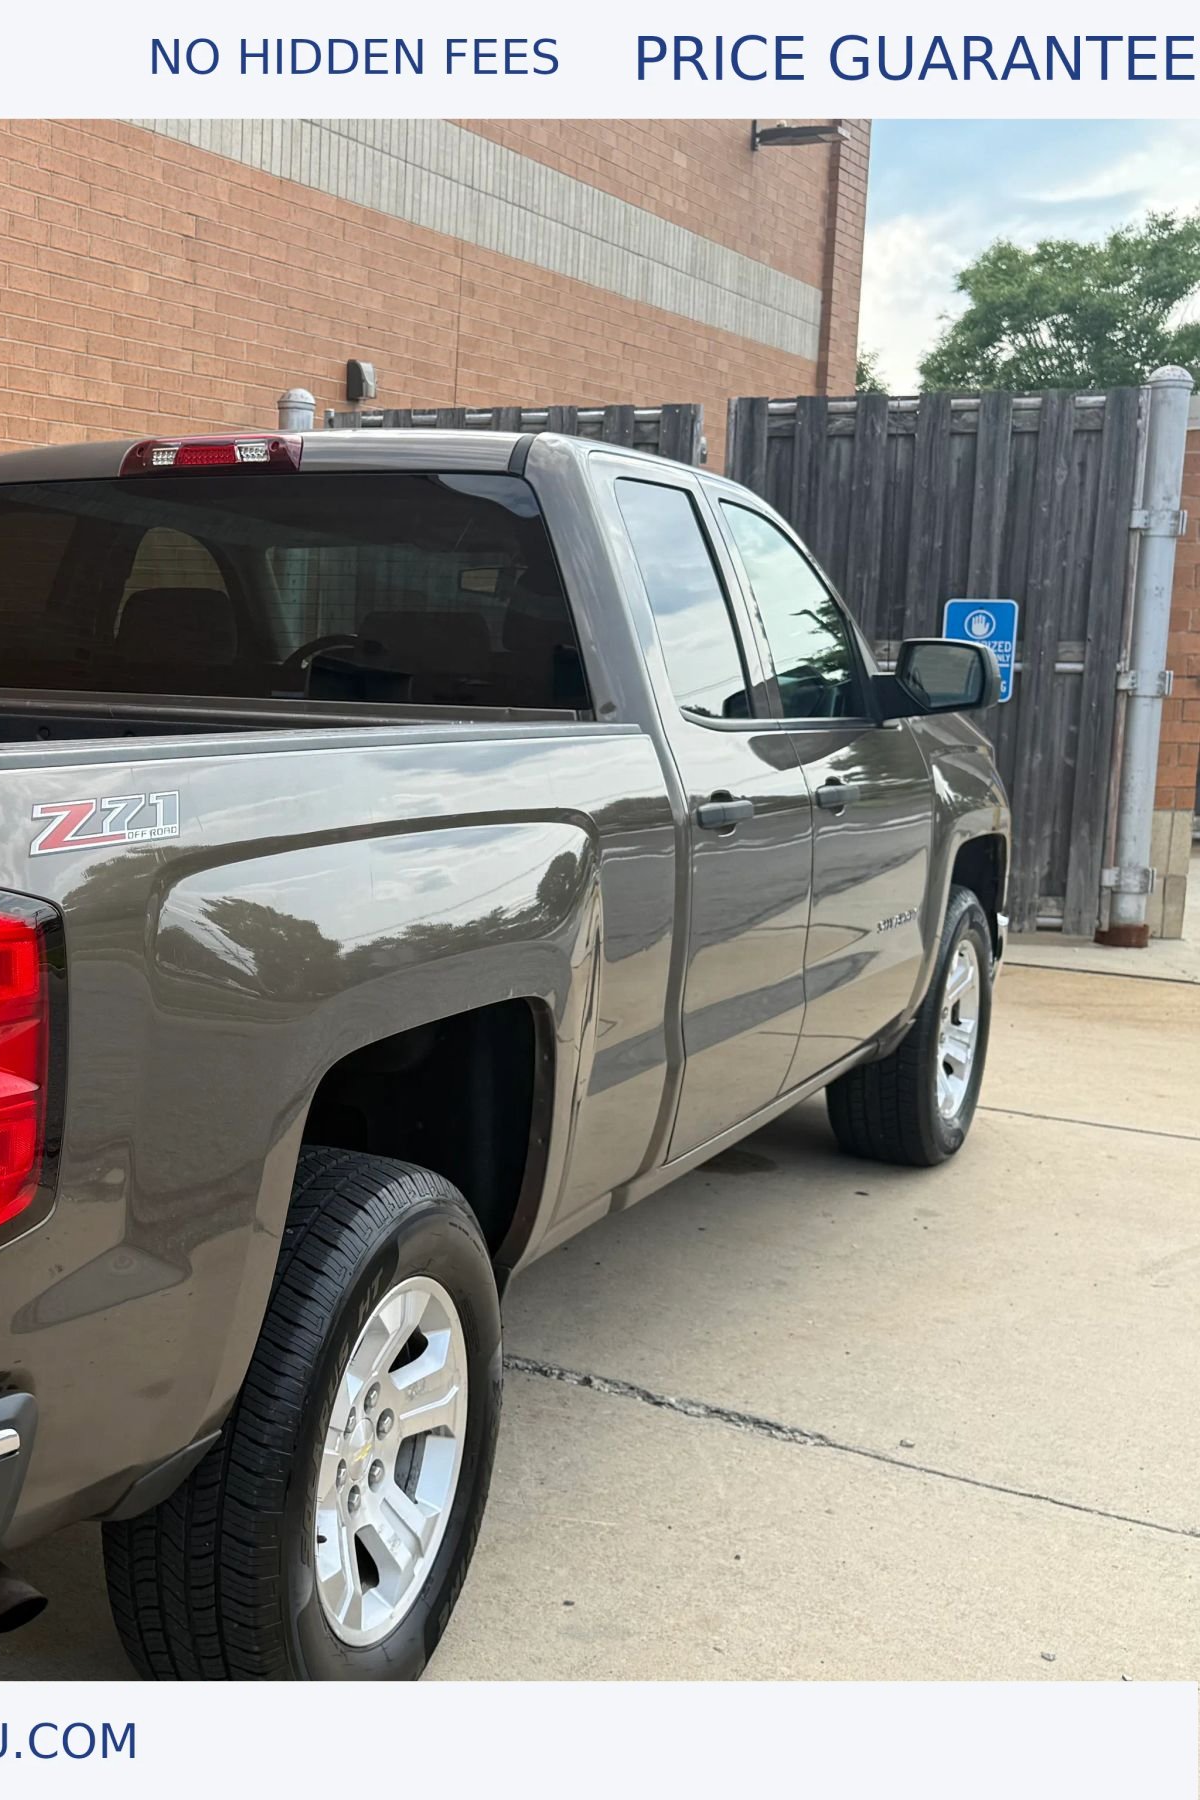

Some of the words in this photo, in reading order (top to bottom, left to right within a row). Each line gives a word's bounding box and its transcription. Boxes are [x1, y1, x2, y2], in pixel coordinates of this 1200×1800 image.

[29, 790, 180, 857] Z71
[127, 831, 147, 840] OFF
[150, 826, 177, 837] ROAD
